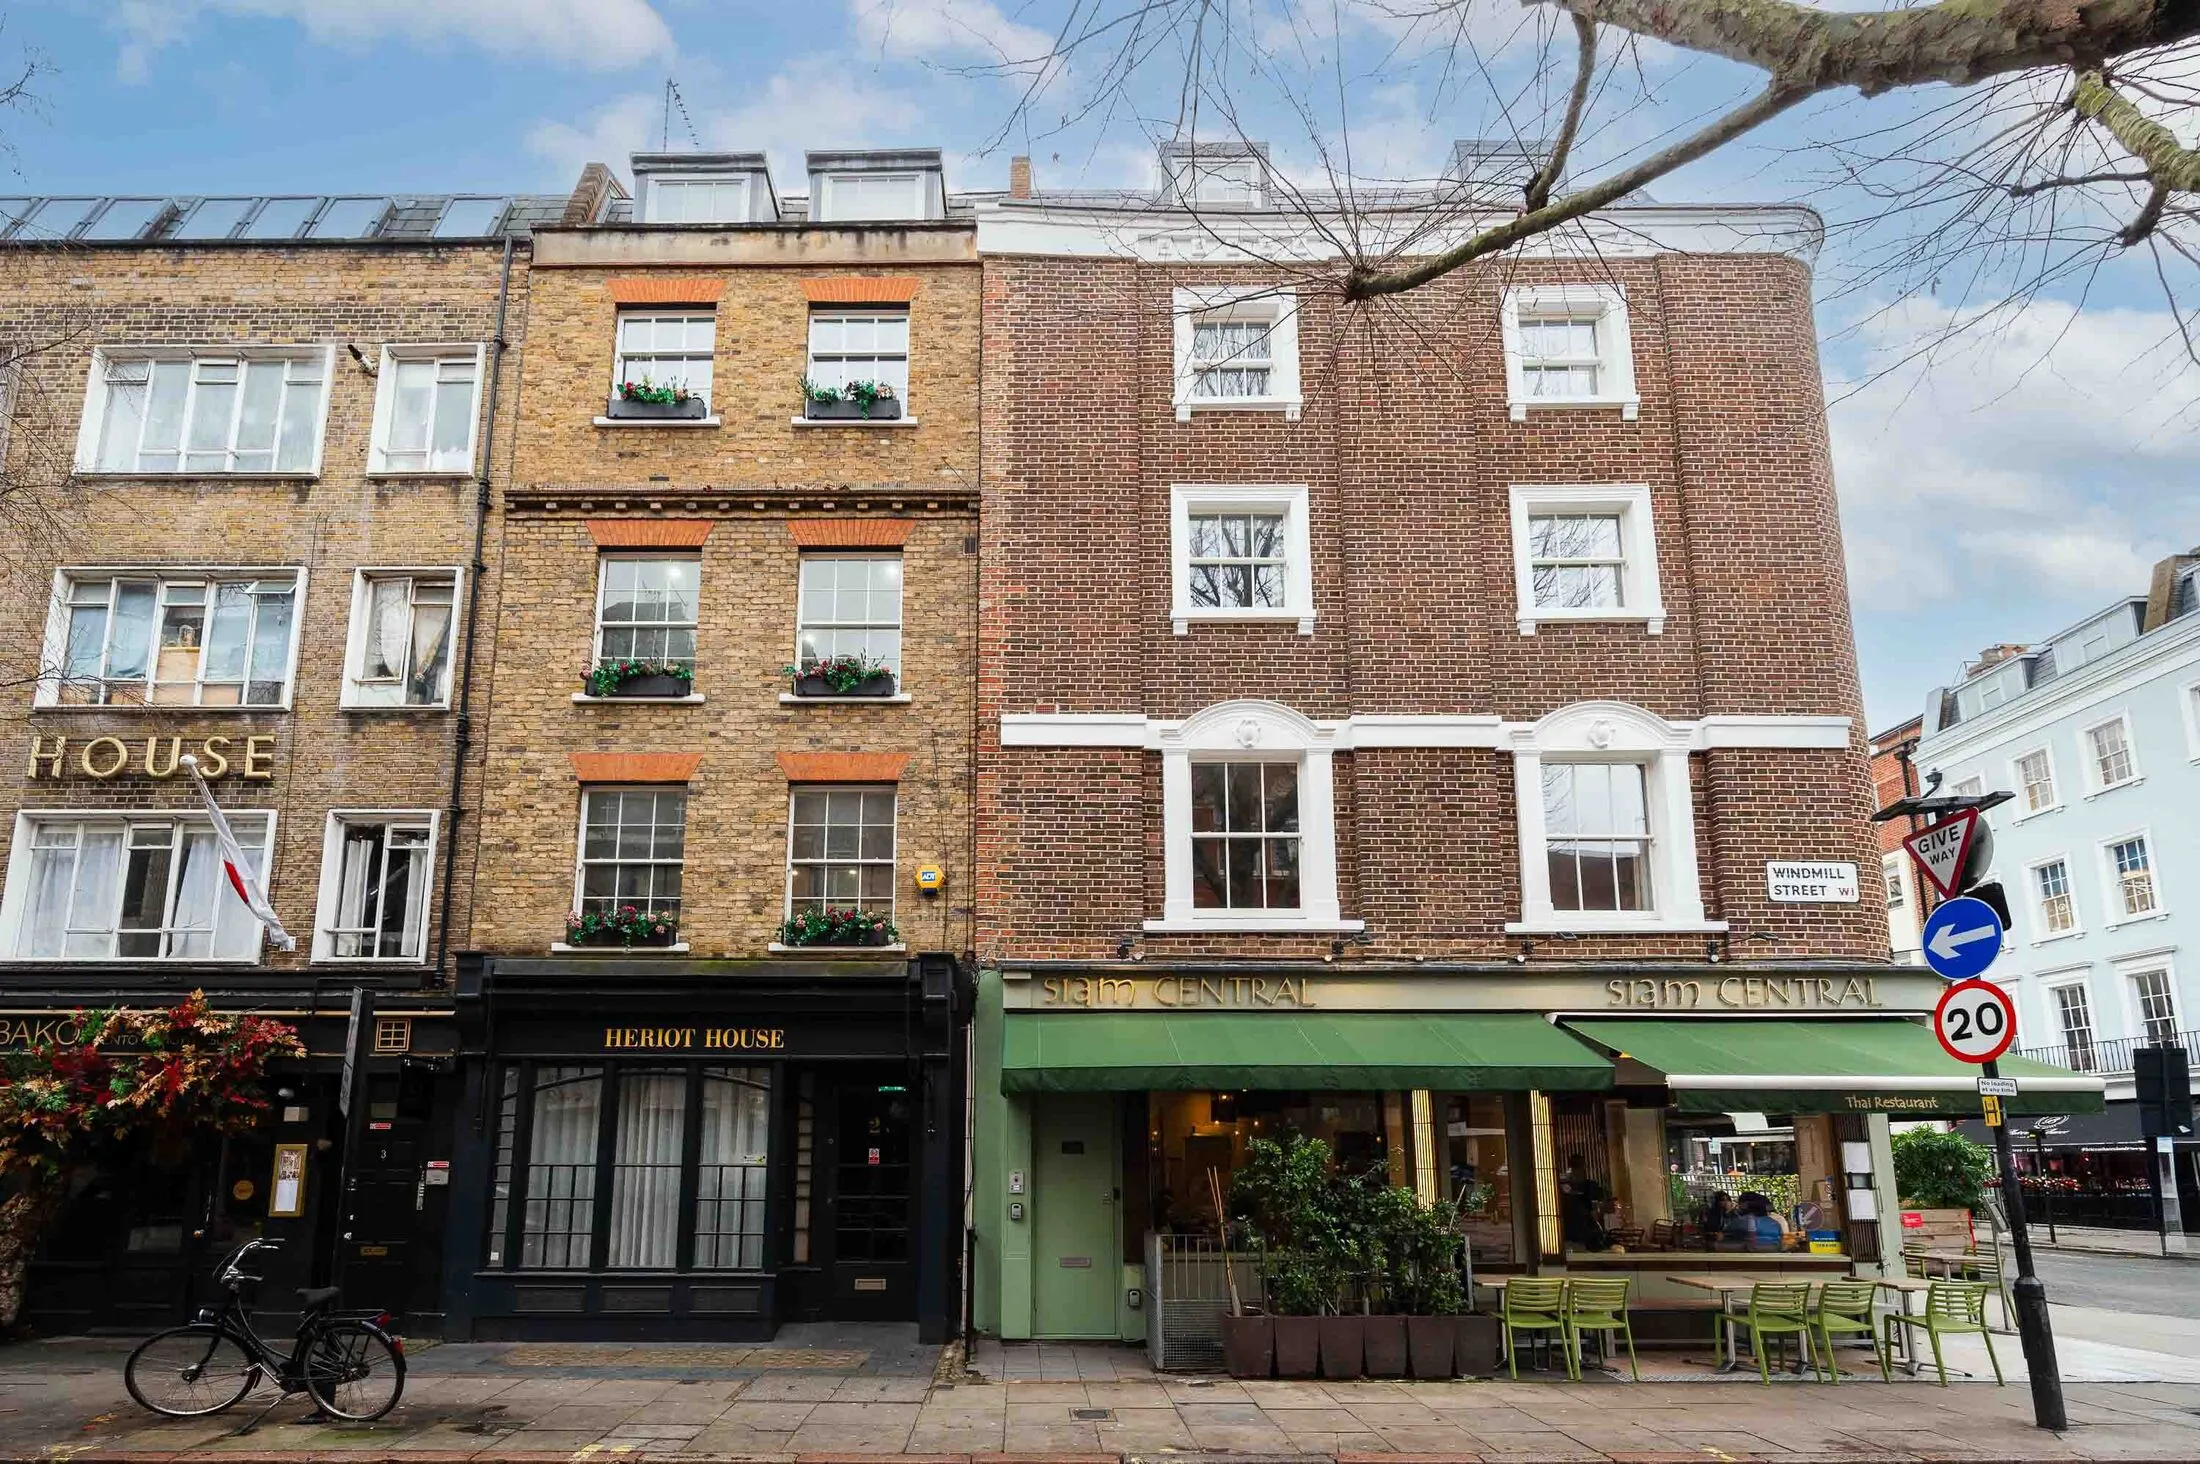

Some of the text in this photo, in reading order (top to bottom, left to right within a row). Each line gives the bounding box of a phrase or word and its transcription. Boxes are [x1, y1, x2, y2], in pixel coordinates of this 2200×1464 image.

[28, 736, 277, 779] HOUSE
[1918, 825, 1960, 853] GIVE
[1929, 847, 1956, 865] WAY
[1772, 867, 1845, 879] WINDMILL
[1774, 884, 1827, 896] STREET
[1153, 976, 1317, 1007] CENTRAL
[1717, 977, 1883, 1008] CENTRAL
[1947, 1002, 2004, 1041] 20
[604, 1028, 785, 1049] HERIOT HOUSE
[1845, 1094, 1939, 1109] Thai Restaurant
[1984, 1099, 1998, 1123] H
[868, 1116, 881, 1134] 2
[380, 1149, 387, 1159] 3
